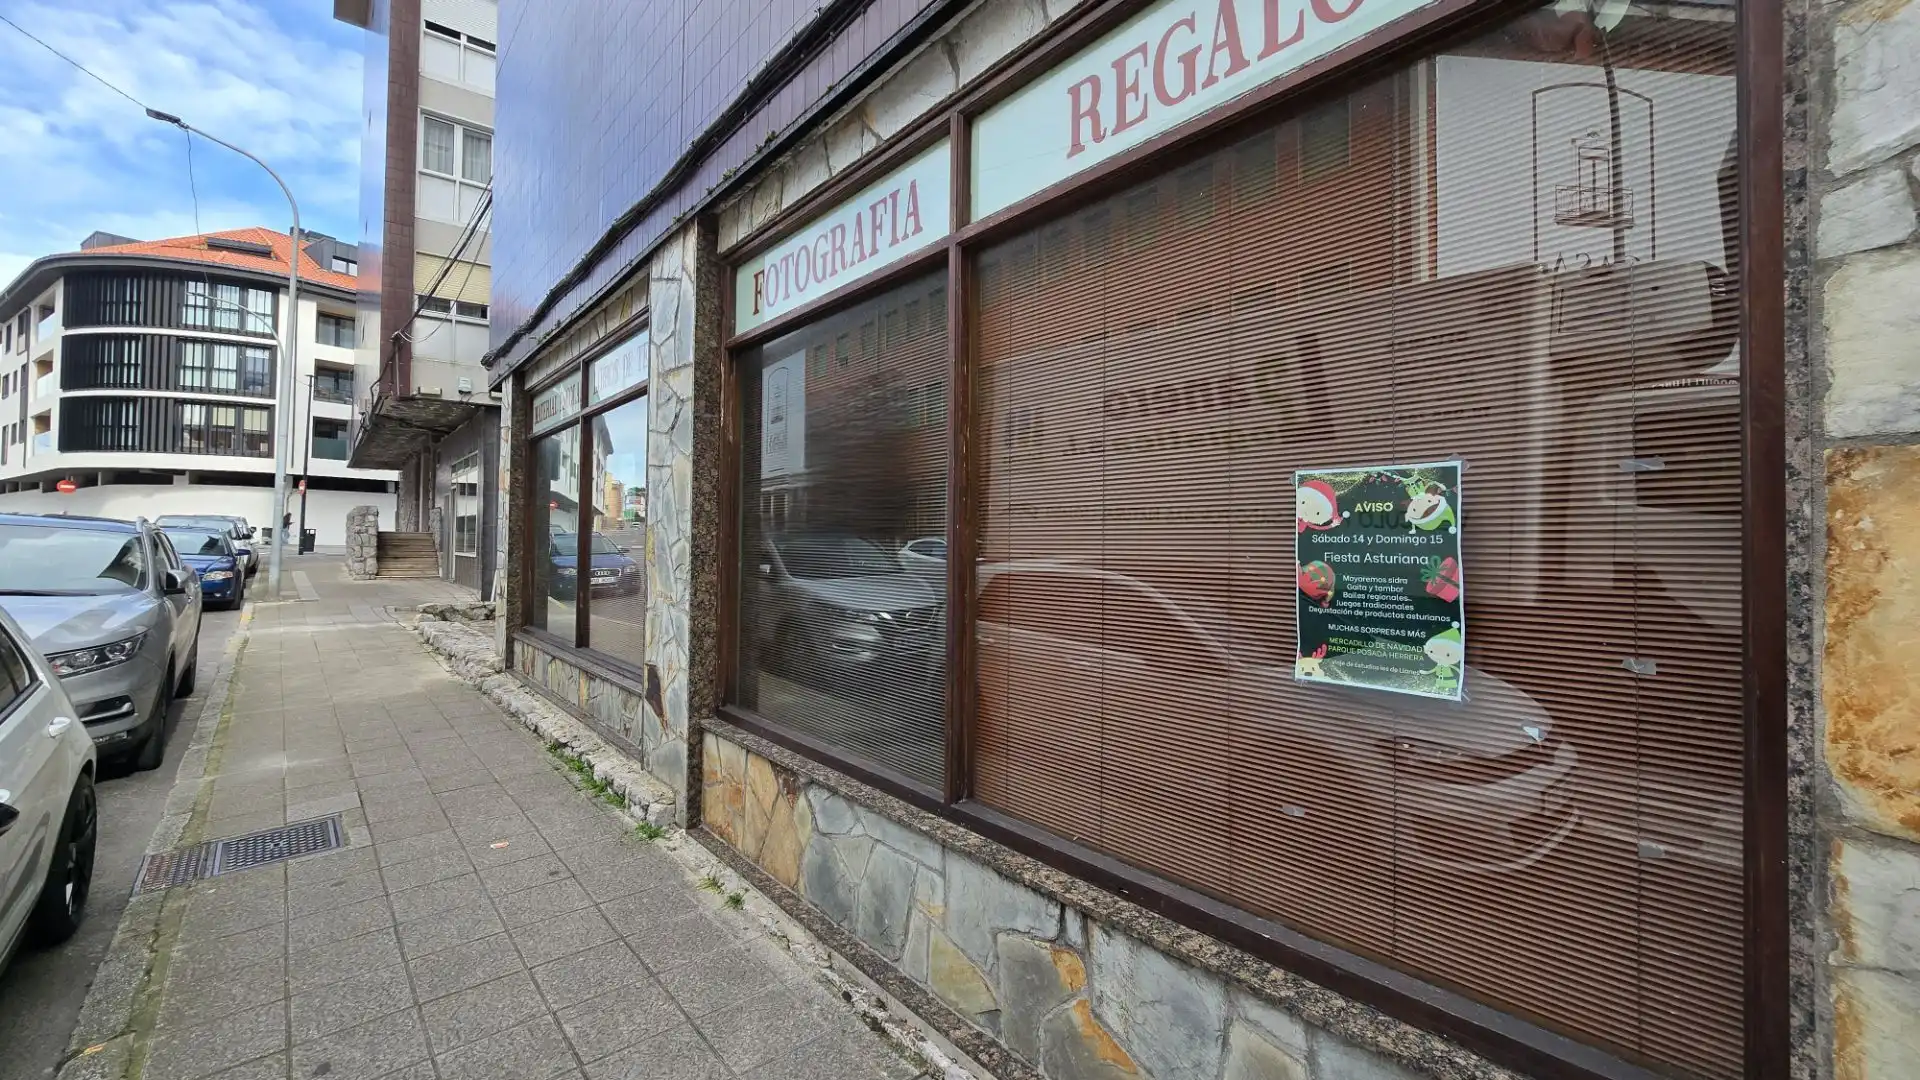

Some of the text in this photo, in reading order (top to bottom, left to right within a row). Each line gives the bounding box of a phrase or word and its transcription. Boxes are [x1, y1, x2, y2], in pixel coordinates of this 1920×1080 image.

[1066, 0, 1364, 159] REGAL
[753, 179, 923, 316] FOTOGRAFIA
[1354, 502, 1393, 512] AVISO
[1312, 534, 1444, 546] Sábado 14 y Domingo 15
[1324, 552, 1429, 565] Fiesta Asturiana
[1346, 583, 1367, 591] Gaita
[1342, 591, 1366, 599] Bailes
[1336, 600, 1414, 611] Juegos tradicionales
[1308, 606, 1451, 622] Degustación de productos asturianos
[1328, 623, 1426, 639] MUCHAS SORPRESAS MÁS
[1329, 637, 1423, 653] MERCADILLO DE NAVIDAD
[1328, 645, 1424, 661] PARQUE POSADA HERRERA
